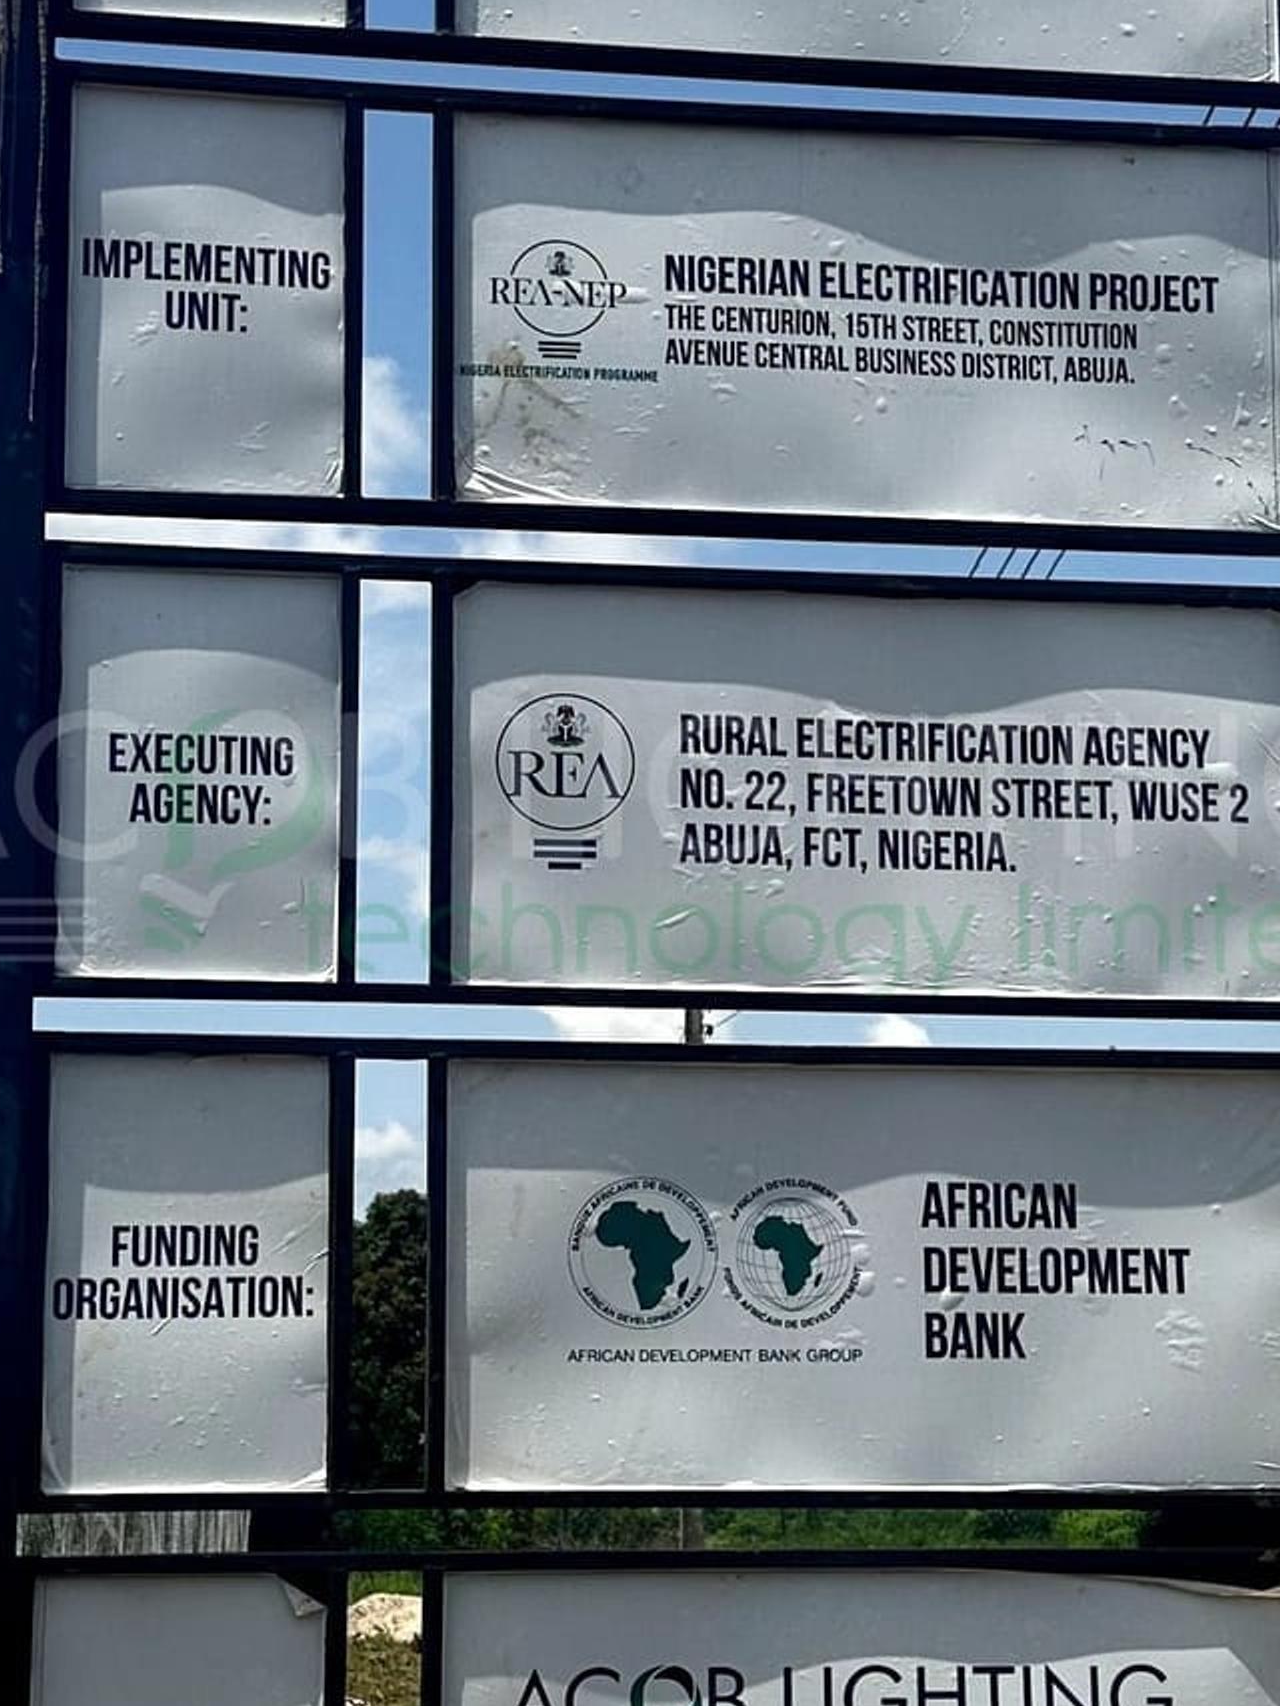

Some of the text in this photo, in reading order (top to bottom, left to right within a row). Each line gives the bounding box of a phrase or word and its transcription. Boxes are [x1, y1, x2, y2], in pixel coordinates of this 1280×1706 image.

[81, 237, 331, 290] IMPLEMENTING
[664, 254, 1220, 314] NIGERIAN ELECTRIFICATION PROJECT
[165, 290, 248, 333] UNIT:
[489, 276, 627, 309] REA-NEP
[664, 303, 1138, 350] THE CENTURION, 15TH STREET, CONSTITUTION
[460, 364, 659, 383] NIGERIA ELECTRIFICATION PROGRAMME
[664, 338, 1136, 385] AVENUE CENTRAL BUSINESS DISTRICT, ABUJA.
[108, 732, 294, 777] EXECUTING
[679, 712, 1210, 769] RURAL ELECTRIFICATION AGENCY
[508, 749, 623, 799] REA
[680, 767, 1251, 824] NO. 22, FREETOWN STREET, WUSE 2
[128, 782, 272, 826] AGENCY:
[679, 823, 1017, 874] ABUJA, FCT, NIGERIA.
[730, 1187, 765, 1221] AFRICAN
[765, 1177, 840, 1202] DEVELOPMENT
[921, 1181, 1078, 1230] AFRICAN
[111, 1224, 260, 1268] FUNDING
[923, 1246, 1191, 1295] DEVELOPMENT
[52, 1274, 315, 1321] ORGANISATION:
[582, 1286, 616, 1318] AFRICAN
[682, 1285, 705, 1309] BANK
[567, 1348, 864, 1364] AFRICAN DEVELOPMENT BANK GROUP
[925, 1311, 1027, 1360] BANK
